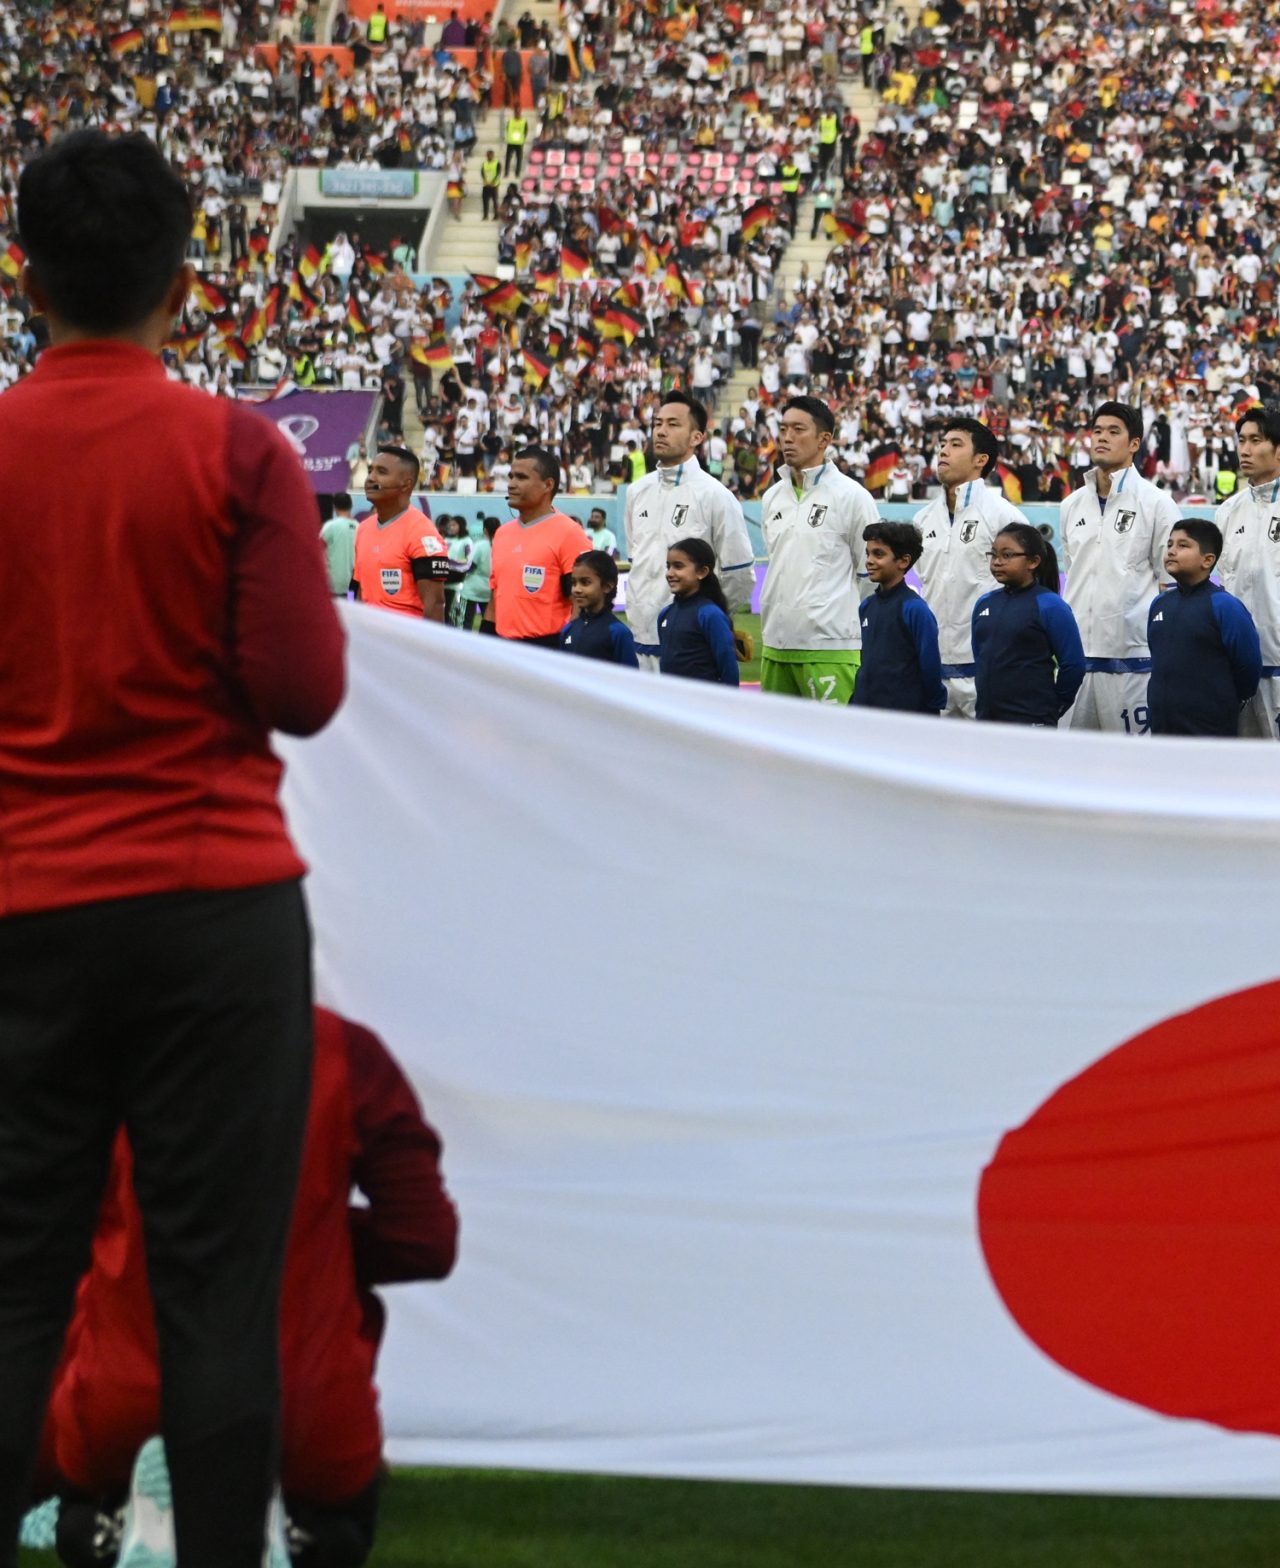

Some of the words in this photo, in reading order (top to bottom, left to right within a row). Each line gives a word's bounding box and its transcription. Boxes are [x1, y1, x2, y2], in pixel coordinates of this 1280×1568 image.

[382, 570, 400, 578] FIFA
[525, 566, 543, 575] FIFA
[807, 675, 838, 704] 12
